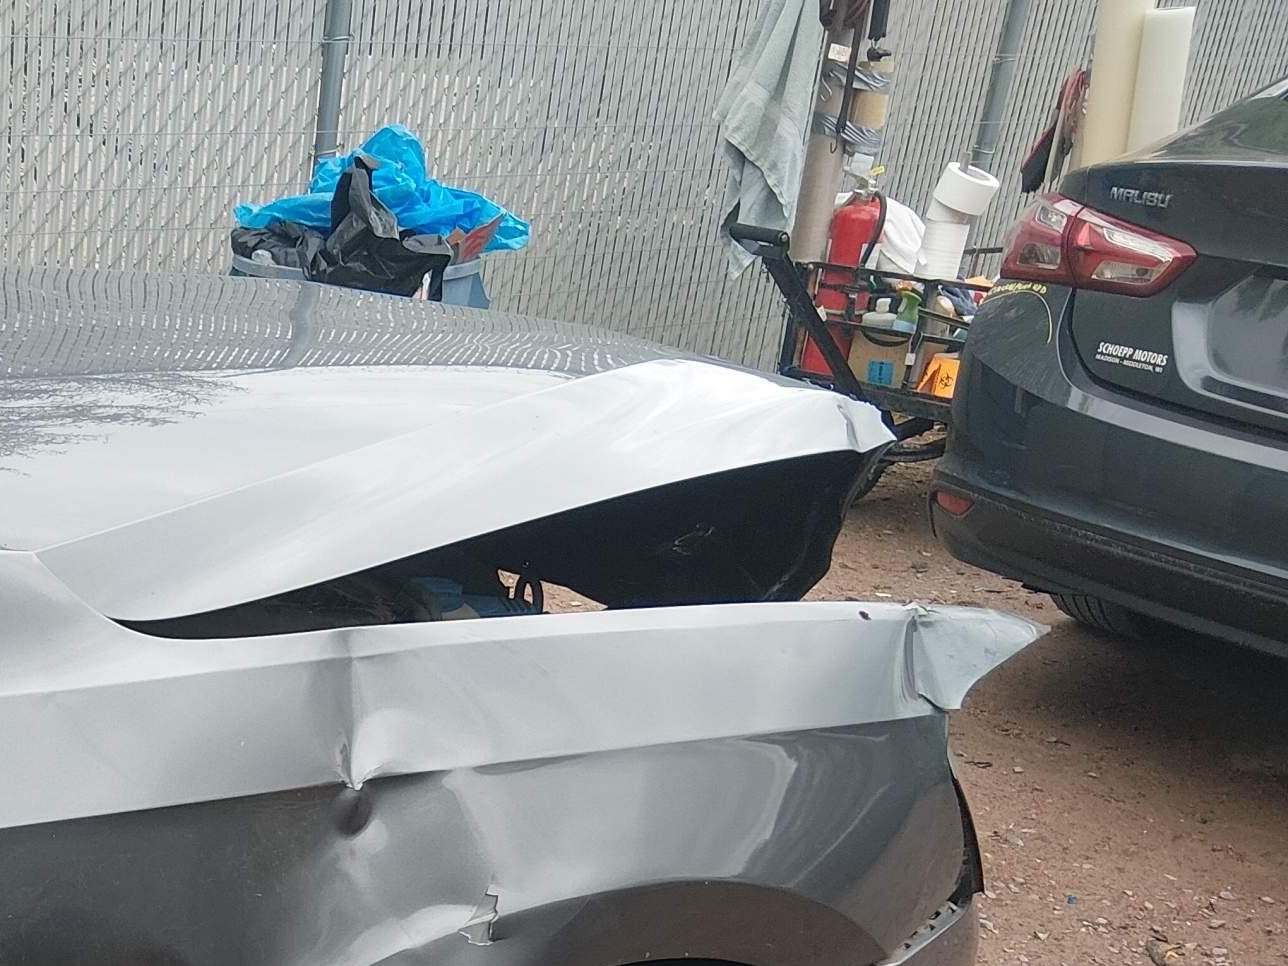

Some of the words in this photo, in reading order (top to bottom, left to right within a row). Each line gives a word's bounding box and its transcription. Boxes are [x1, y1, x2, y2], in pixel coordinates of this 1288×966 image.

[1111, 187, 1173, 208] MALIBU
[1097, 341, 1134, 359] SCHOEPP
[1133, 348, 1169, 366] MOTORS
